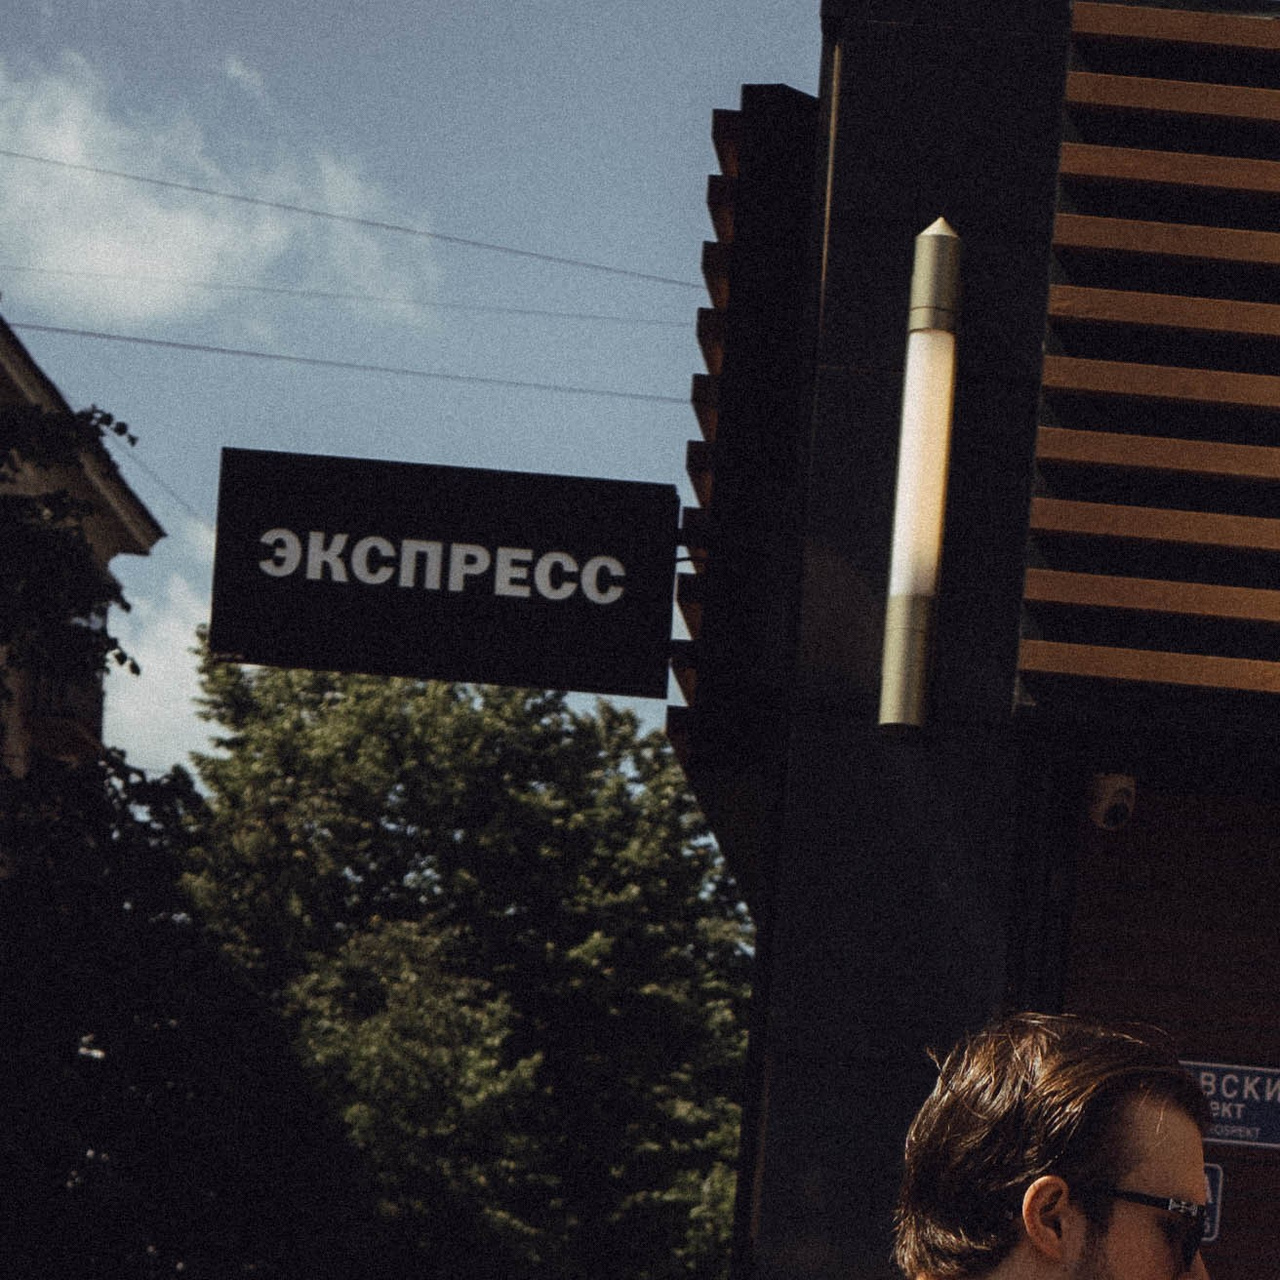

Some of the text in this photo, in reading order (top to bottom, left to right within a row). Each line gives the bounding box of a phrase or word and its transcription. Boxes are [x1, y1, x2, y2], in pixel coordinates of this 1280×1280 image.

[259, 527, 626, 604] ЭКСПРЕСС
[1210, 1101, 1246, 1119] ект
[1210, 1124, 1261, 1140] OSPEKT
